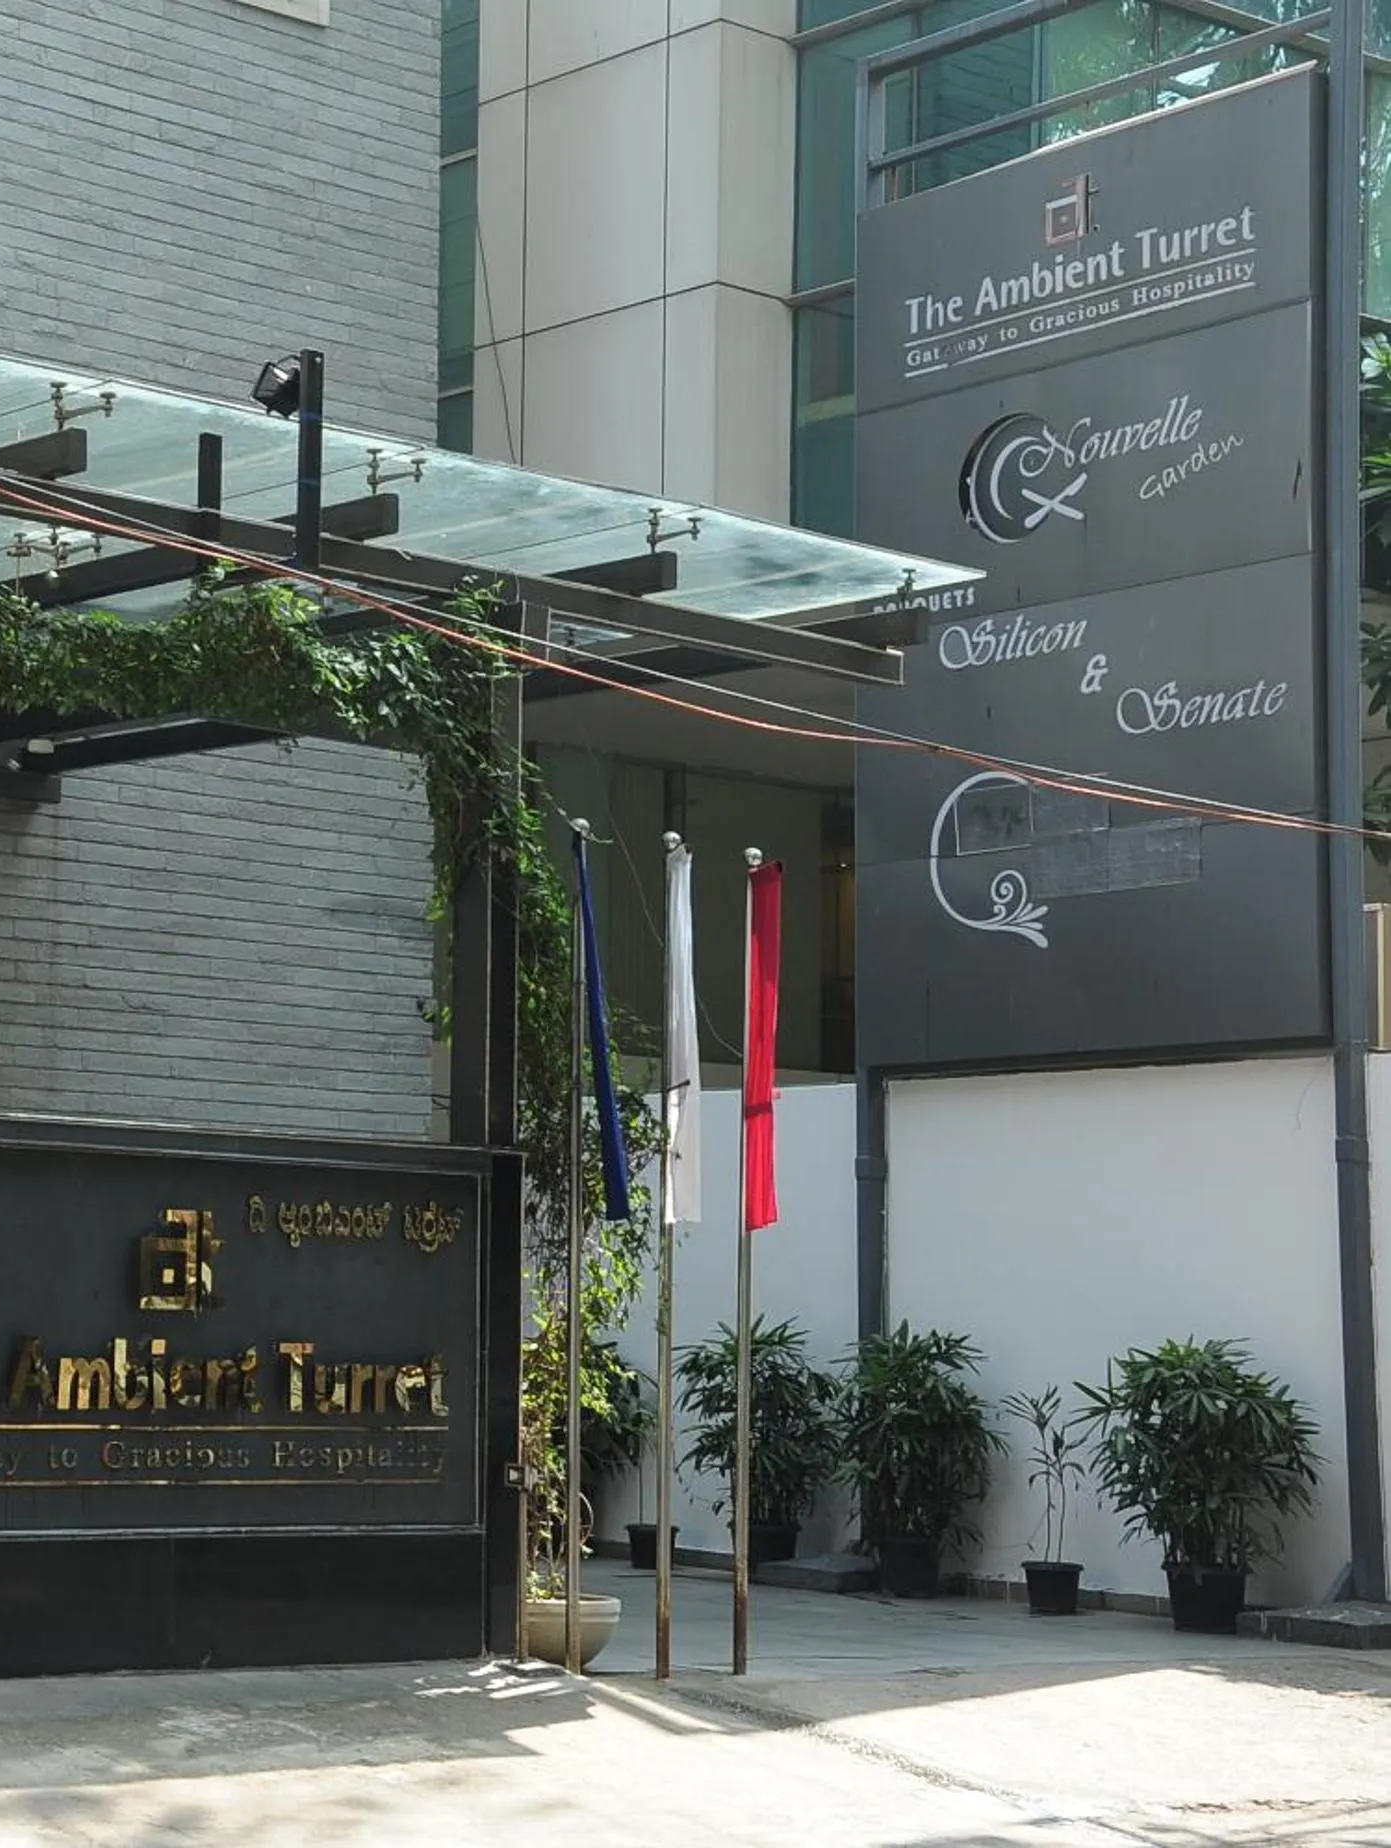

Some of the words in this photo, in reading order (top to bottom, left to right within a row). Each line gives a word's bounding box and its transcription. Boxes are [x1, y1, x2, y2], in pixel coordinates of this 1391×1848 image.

[905, 293, 964, 334] The
[974, 241, 1126, 317] Ambient
[1135, 204, 1257, 270] Turret
[999, 324, 1018, 342] to
[1029, 297, 1120, 334] Gracious
[1132, 260, 1256, 306] Hospitality
[1018, 394, 1204, 478] Nouvelle
[1138, 432, 1245, 500] Garden
[939, 613, 1088, 670] Silicon
[1080, 653, 1109, 694] &
[1116, 679, 1288, 735] Senate
[9, 1336, 264, 1414] Ambient
[277, 1341, 450, 1417] Turret
[48, 1443, 79, 1470] to
[102, 1440, 251, 1470] Gracious
